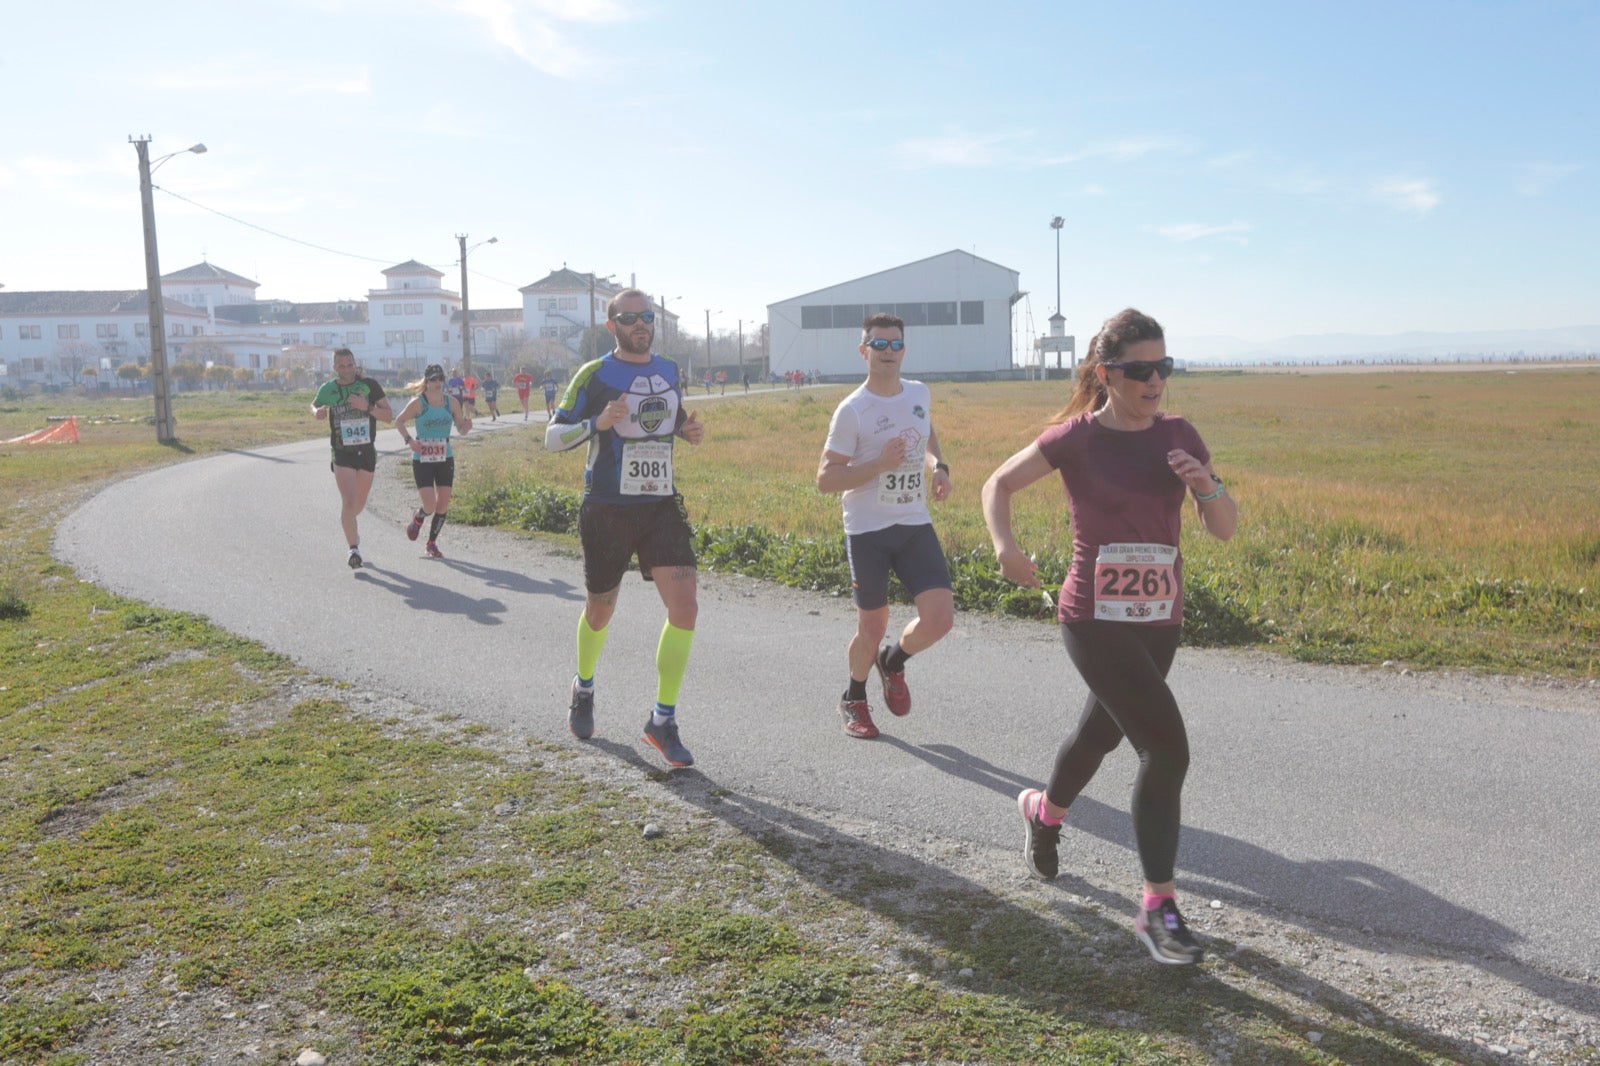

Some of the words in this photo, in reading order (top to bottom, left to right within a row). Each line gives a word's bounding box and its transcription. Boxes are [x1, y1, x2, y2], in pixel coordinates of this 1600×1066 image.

[346, 427, 366, 437] 945
[421, 446, 445, 455] 2031
[629, 461, 667, 478] 3081
[885, 472, 921, 490] 3153
[1100, 568, 1171, 597] 2261
